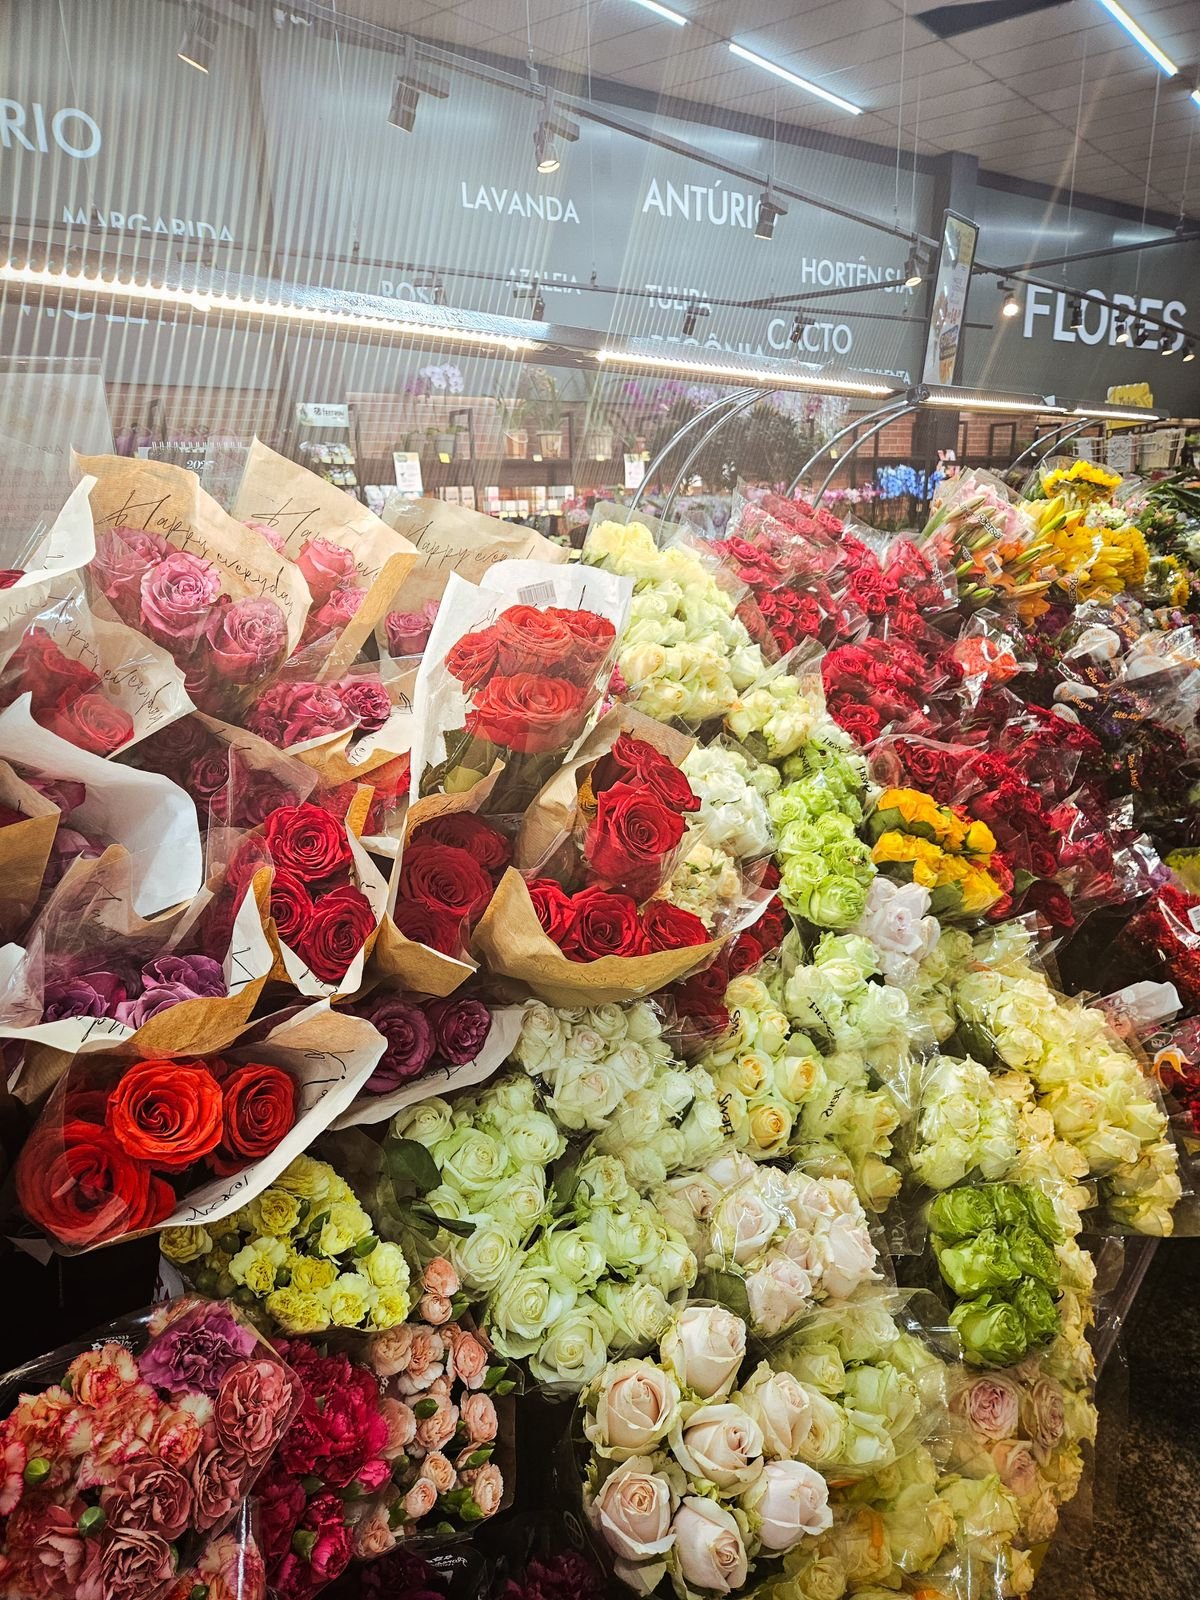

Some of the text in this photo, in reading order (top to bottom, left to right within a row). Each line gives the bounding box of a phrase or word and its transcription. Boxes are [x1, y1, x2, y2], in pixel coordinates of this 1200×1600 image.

[461, 182, 580, 224] LAVANDA
[382, 280, 443, 305] ROS
[1023, 284, 1187, 352] FLORES
